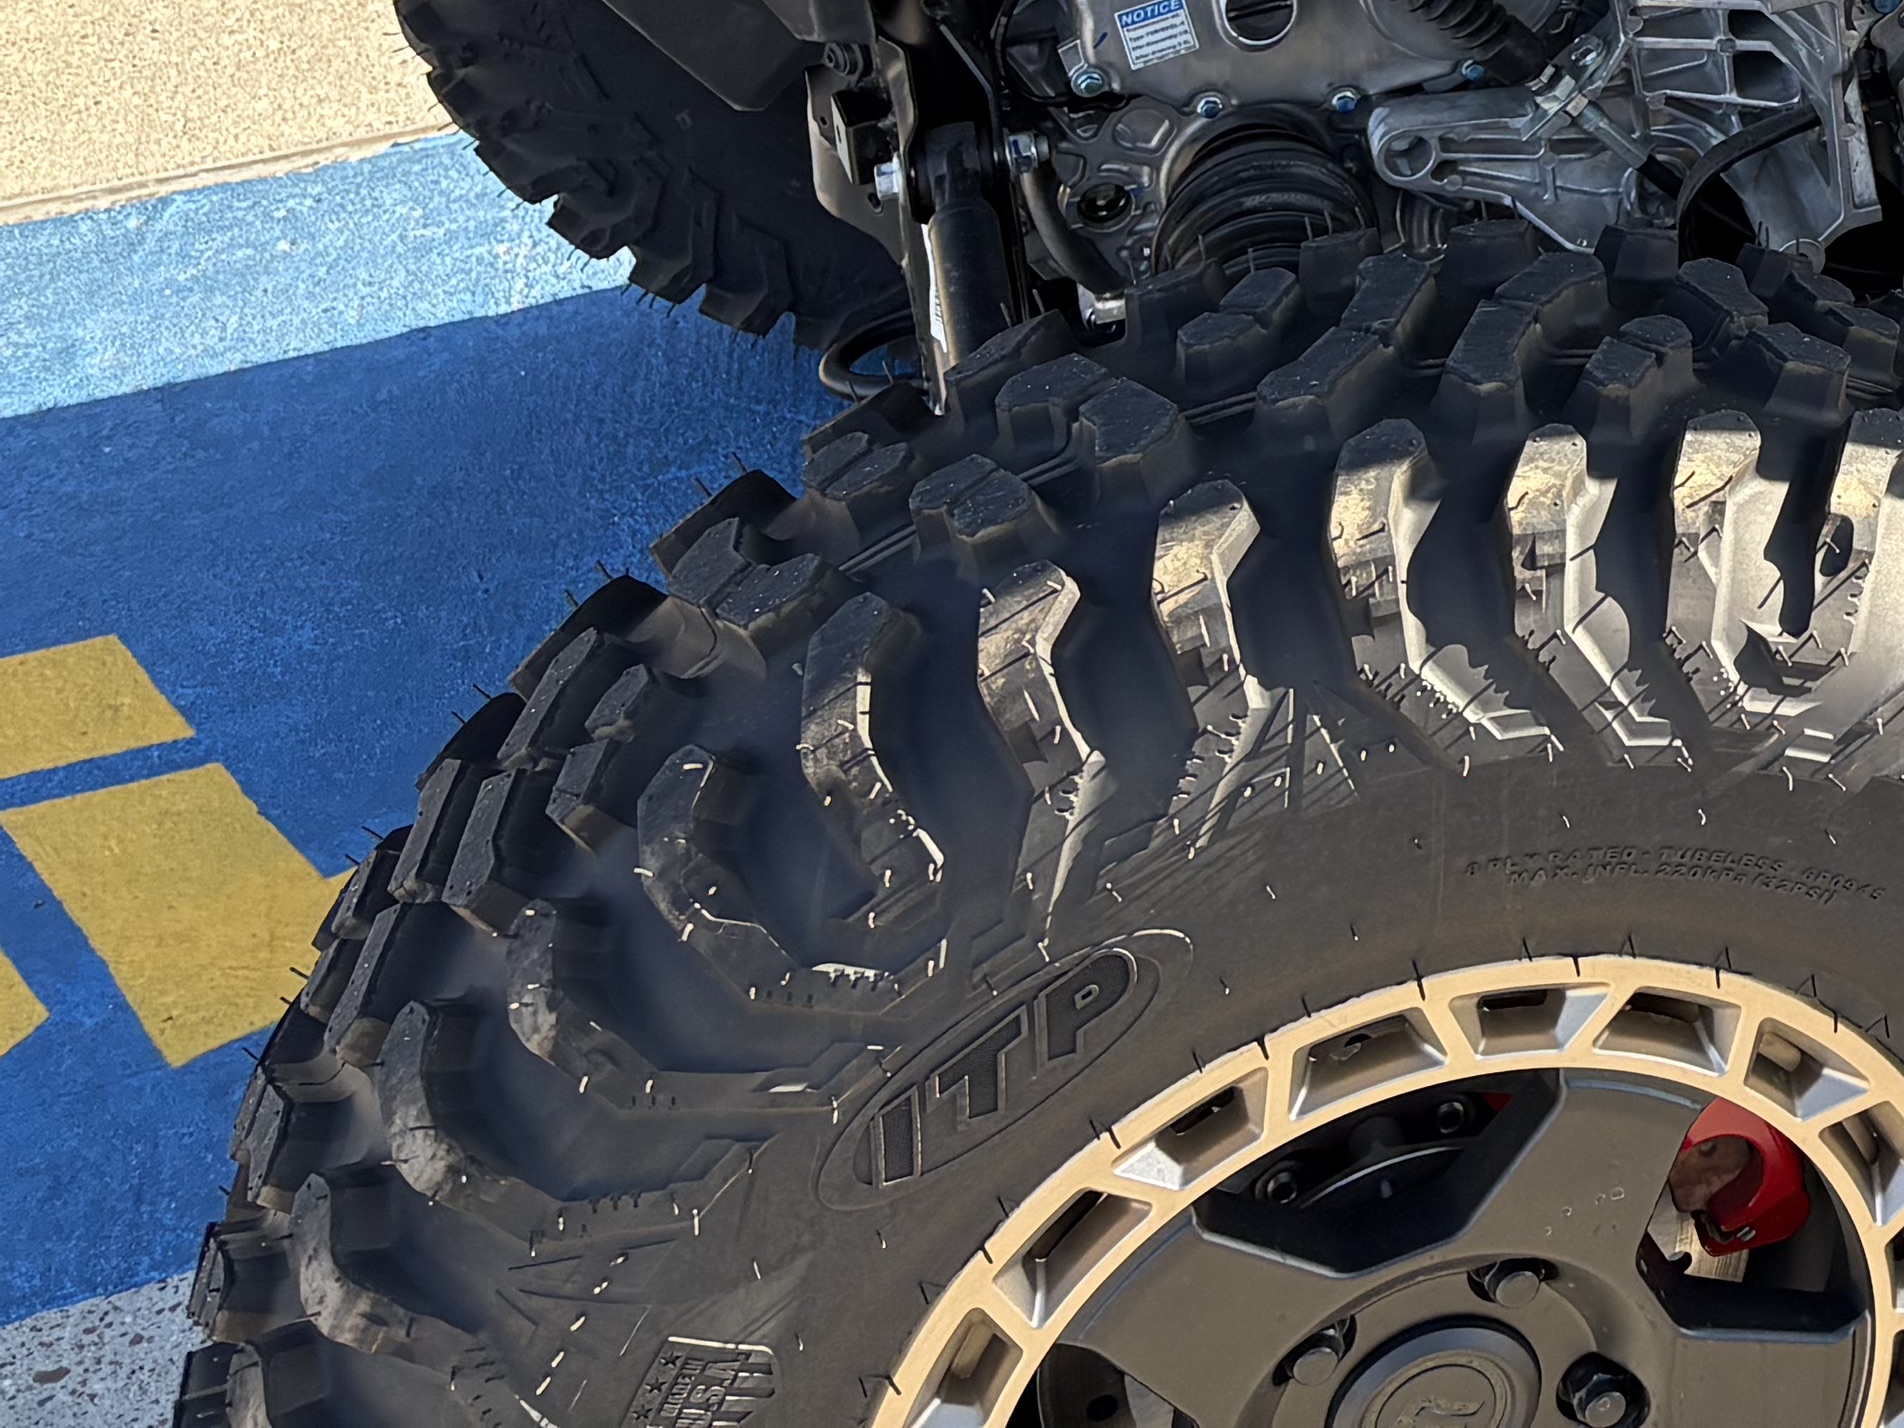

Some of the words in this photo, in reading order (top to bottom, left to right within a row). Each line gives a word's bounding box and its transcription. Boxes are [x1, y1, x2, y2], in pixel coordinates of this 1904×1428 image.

[1487, 852, 1540, 873] PLY
[1548, 846, 1636, 863] RATED
[1658, 845, 1786, 872] TUBELESS
[1507, 865, 1578, 886] MAX.
[1582, 862, 1649, 884] INFL.
[868, 947, 1139, 1189] ITP
